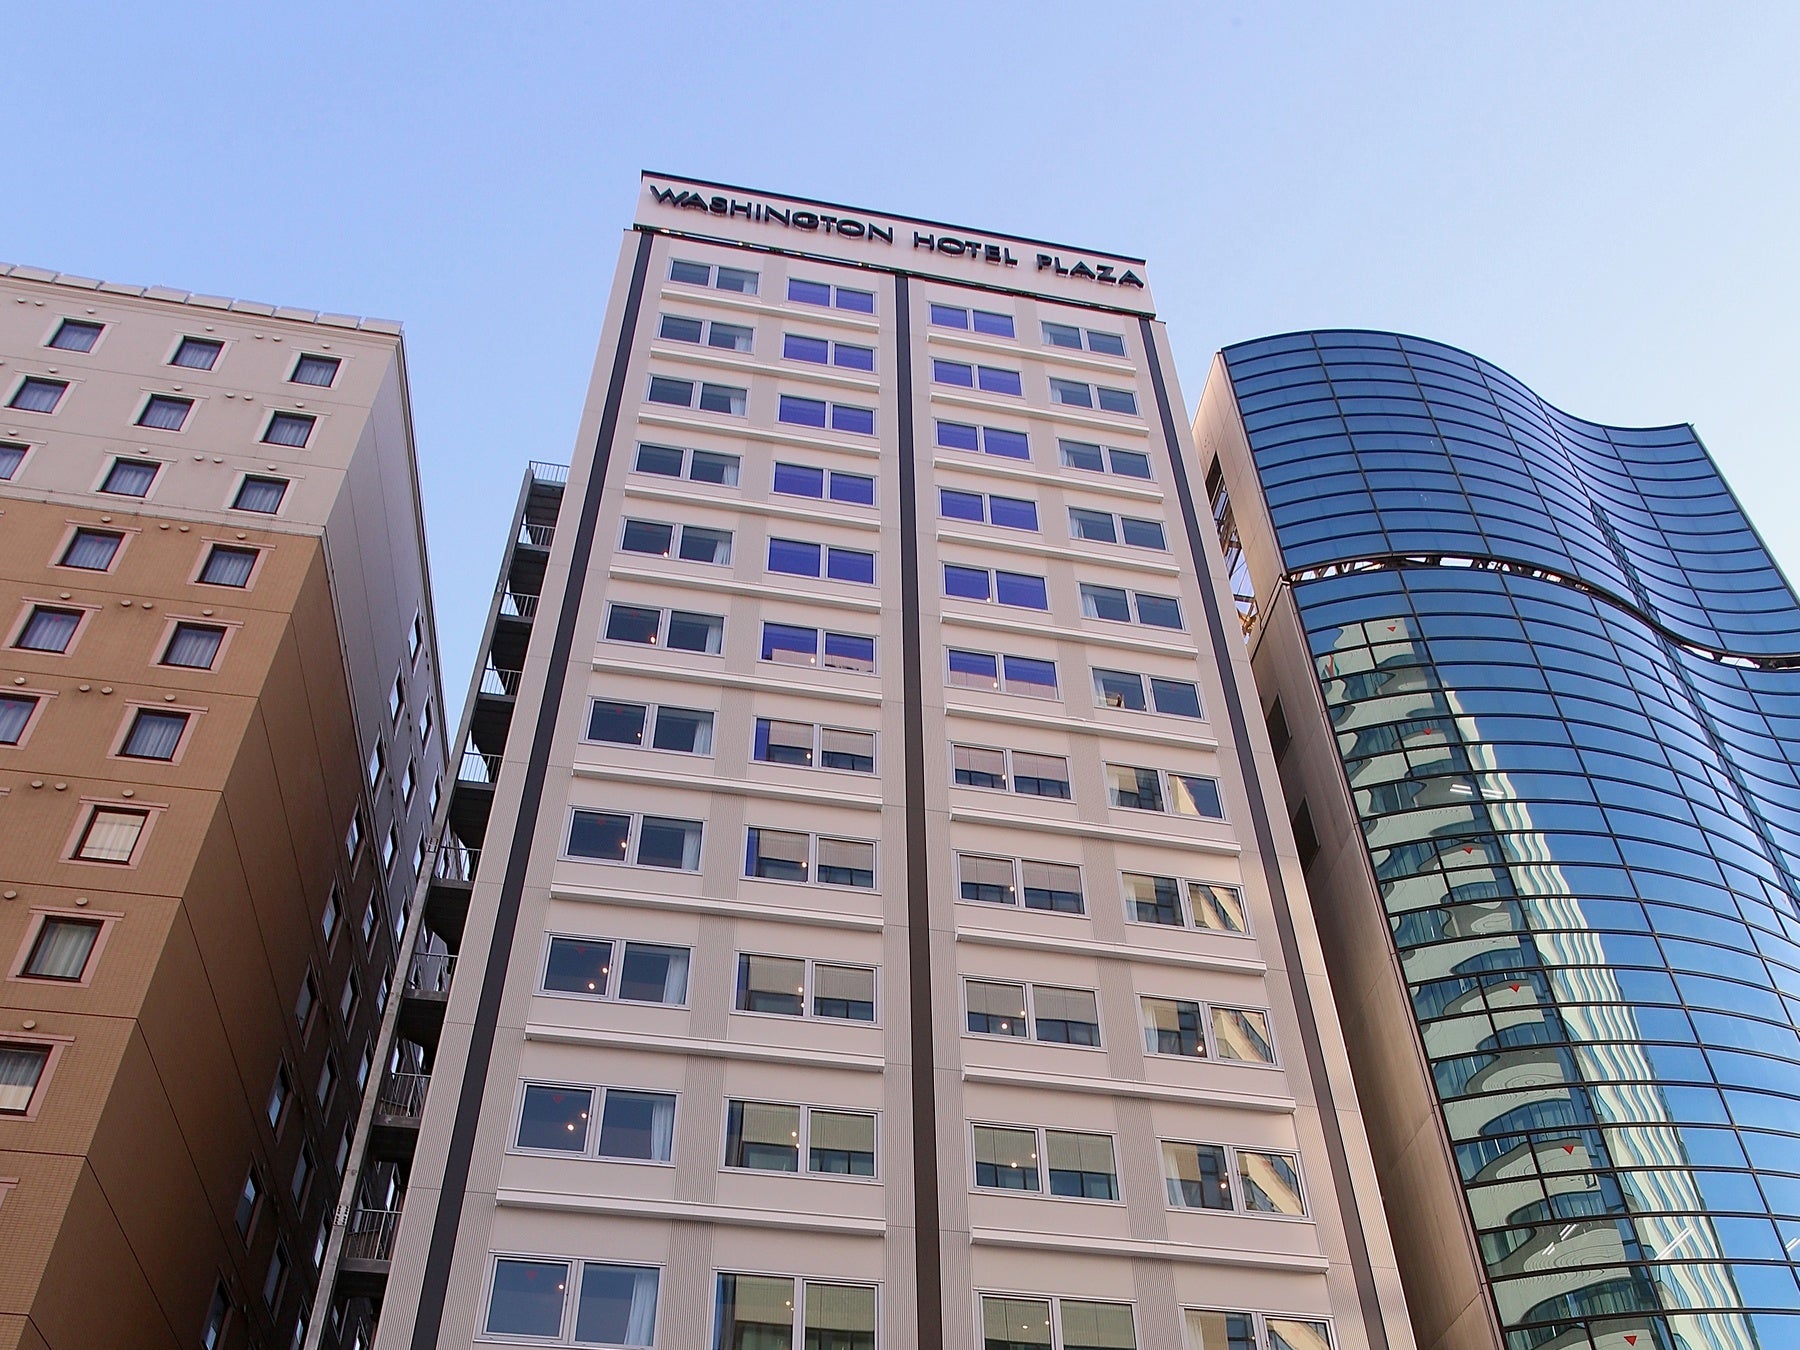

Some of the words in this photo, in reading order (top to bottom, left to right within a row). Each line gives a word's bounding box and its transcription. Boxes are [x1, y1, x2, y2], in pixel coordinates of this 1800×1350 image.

[650, 185, 893, 245] WASHINGTON
[913, 231, 1018, 268] HOTEL
[1036, 253, 1144, 291] PLAZA
